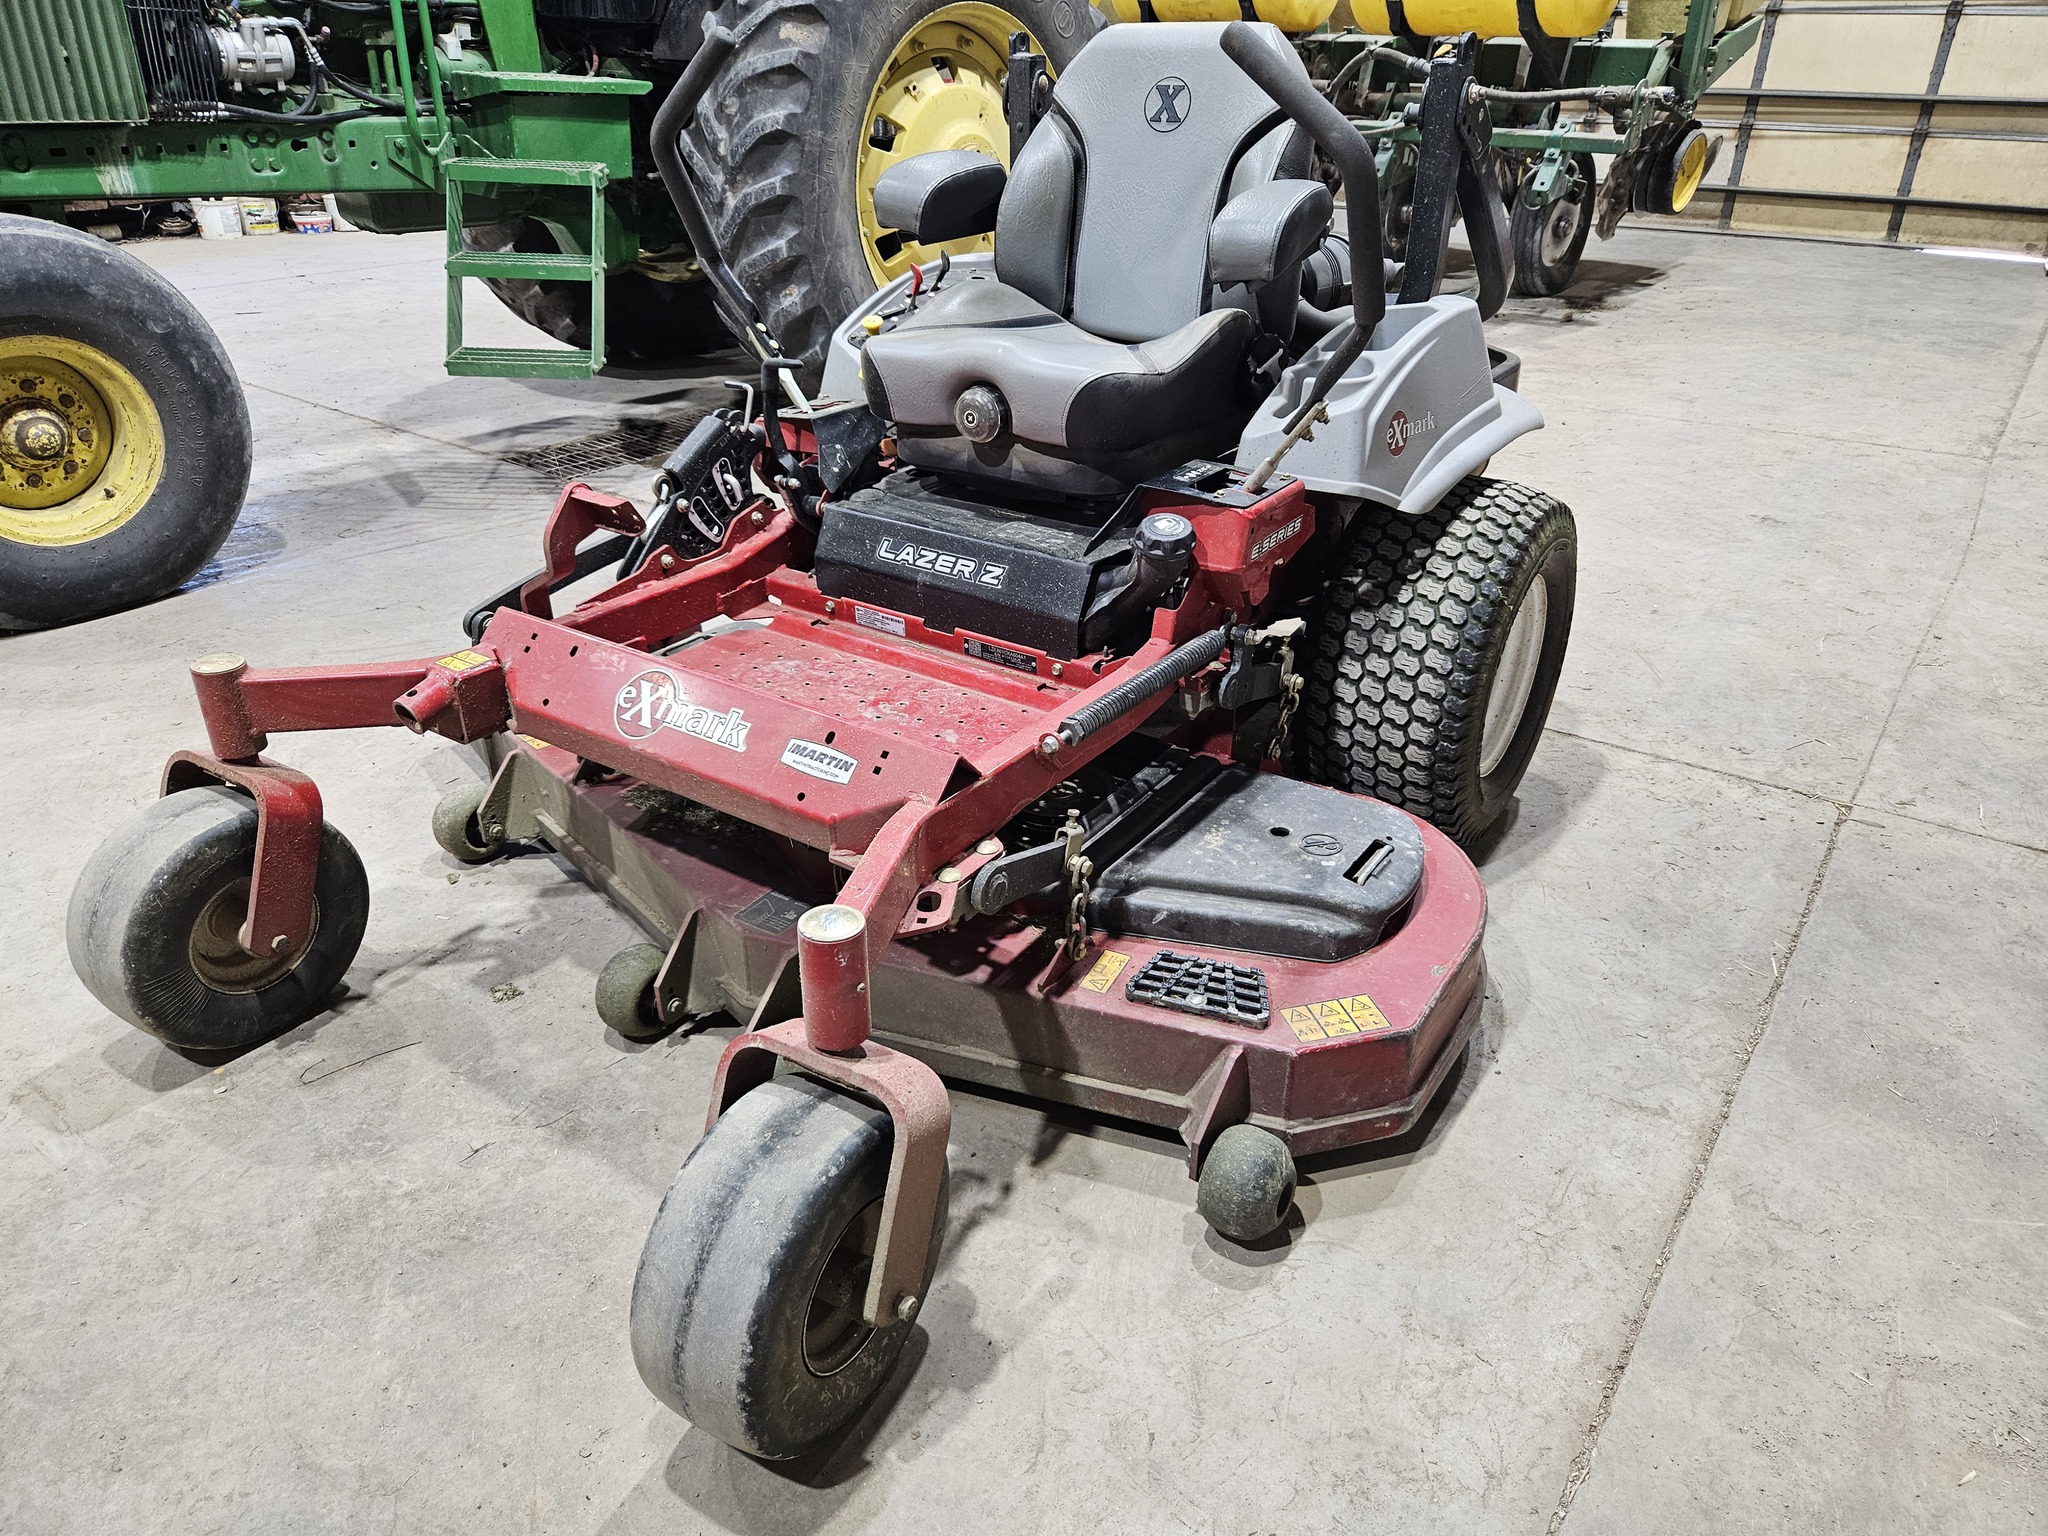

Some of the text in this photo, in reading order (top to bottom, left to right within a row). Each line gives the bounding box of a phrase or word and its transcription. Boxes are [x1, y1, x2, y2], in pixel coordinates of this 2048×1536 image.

[1149, 83, 1186, 123] X
[147, 342, 206, 469] Firestone
[1250, 515, 1304, 561] E-SERIES
[876, 536, 1009, 589] LAZER Z
[790, 743, 855, 773] MARTIN
